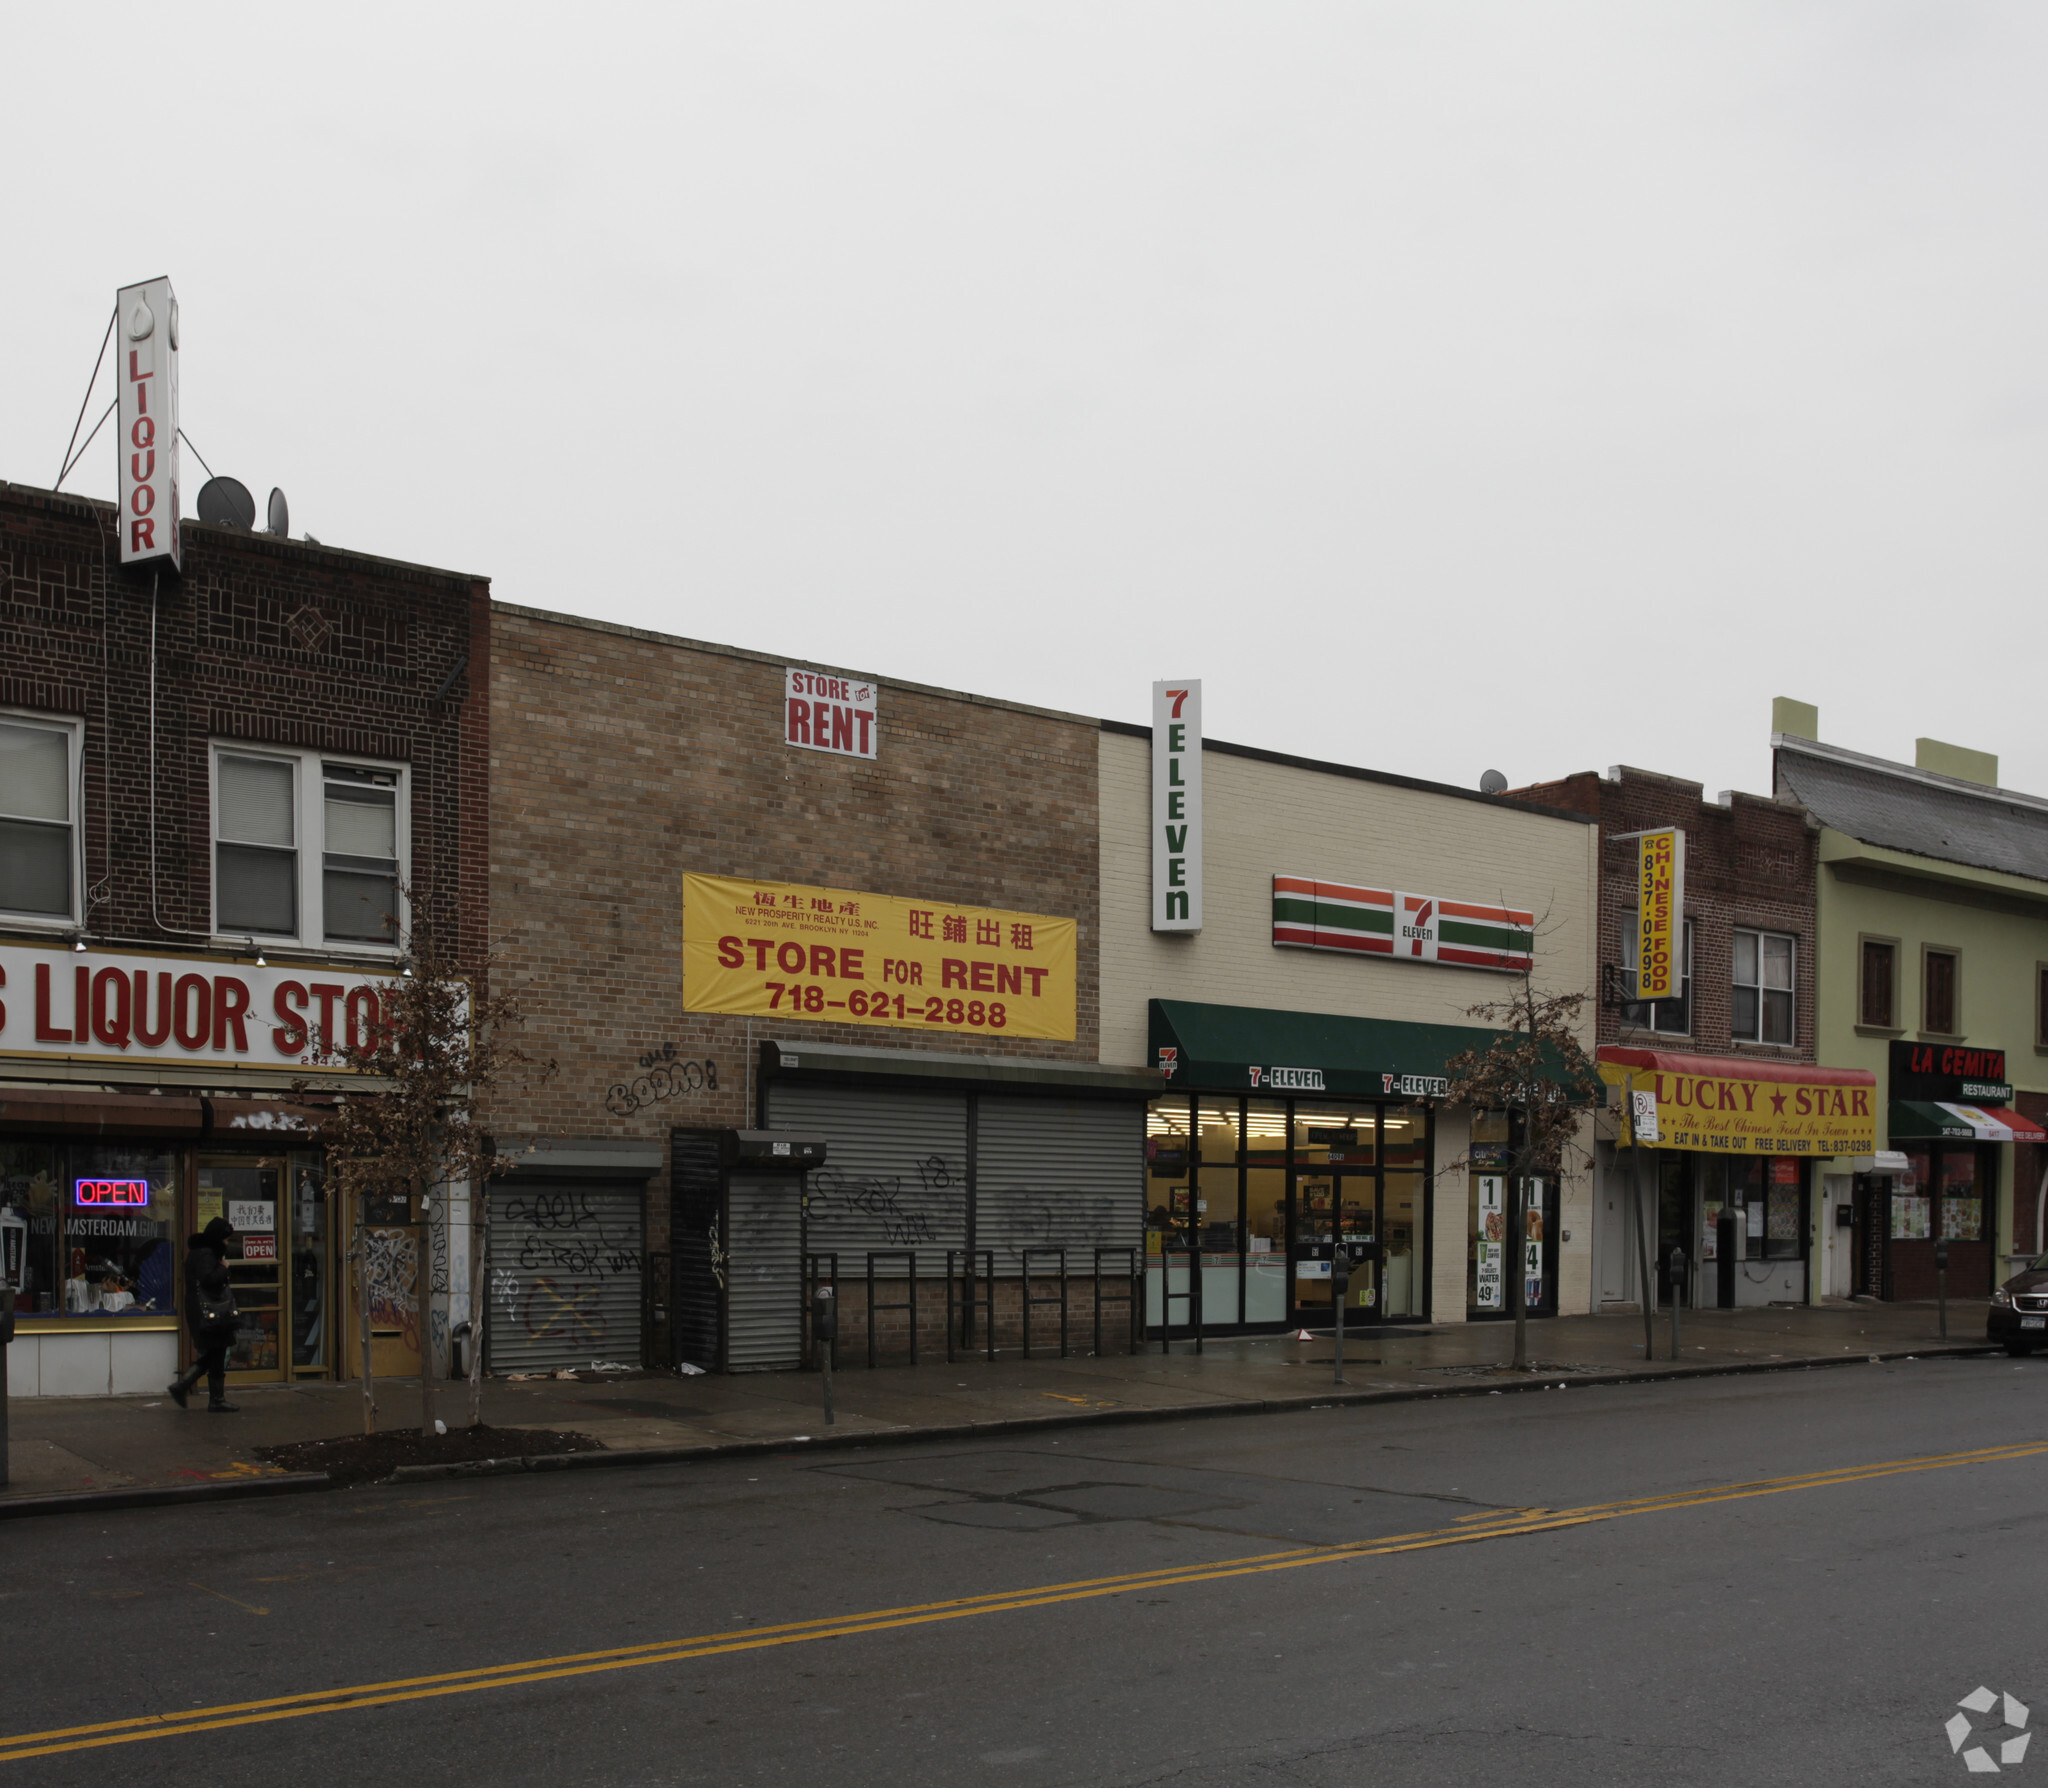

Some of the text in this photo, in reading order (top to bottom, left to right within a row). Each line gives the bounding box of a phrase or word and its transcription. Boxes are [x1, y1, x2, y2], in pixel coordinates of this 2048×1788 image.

[129, 349, 155, 553] LIQUOR
[792, 672, 869, 702] STORE for
[1166, 689, 1188, 718] 7
[788, 697, 874, 754] RENT
[736, 906, 880, 931] NEW PROSPERITY REALTY U.S. INC.
[763, 920, 778, 928] 20th
[799, 924, 837, 934] BROOKLYN
[1404, 896, 1432, 957] 7
[1653, 838, 1670, 992] CHINESE FOOD
[909, 909, 1034, 951] 旺鋪出租
[718, 935, 1049, 998] STORE FOR RENT
[36, 963, 250, 1051] LIQUOR
[765, 981, 1007, 1028] 718-621-2888
[1911, 1046, 2004, 1080] LA CEMITA
[1655, 1073, 1870, 1117] LUCKY STAR
[1962, 1084, 2011, 1099] RESTAURANT
[1679, 1113, 1849, 1137] The Best Chinese Food In Town
[2025, 1132, 2046, 1141] DELIVERY
[1675, 1132, 1689, 1145] EAT
[1691, 1134, 1700, 1146] IN
[1702, 1135, 1708, 1146] &
[1710, 1135, 1729, 1149] TAKE
[1732, 1137, 1747, 1149] OUT
[1755, 1138, 1774, 1151] FREE
[1776, 1139, 1811, 1152] DELIVERY
[79, 1181, 146, 1204] OPEN
[30, 1218, 57, 1235] NEW
[246, 1245, 273, 1257] OPEN
[1479, 1274, 1499, 1283] WATER
